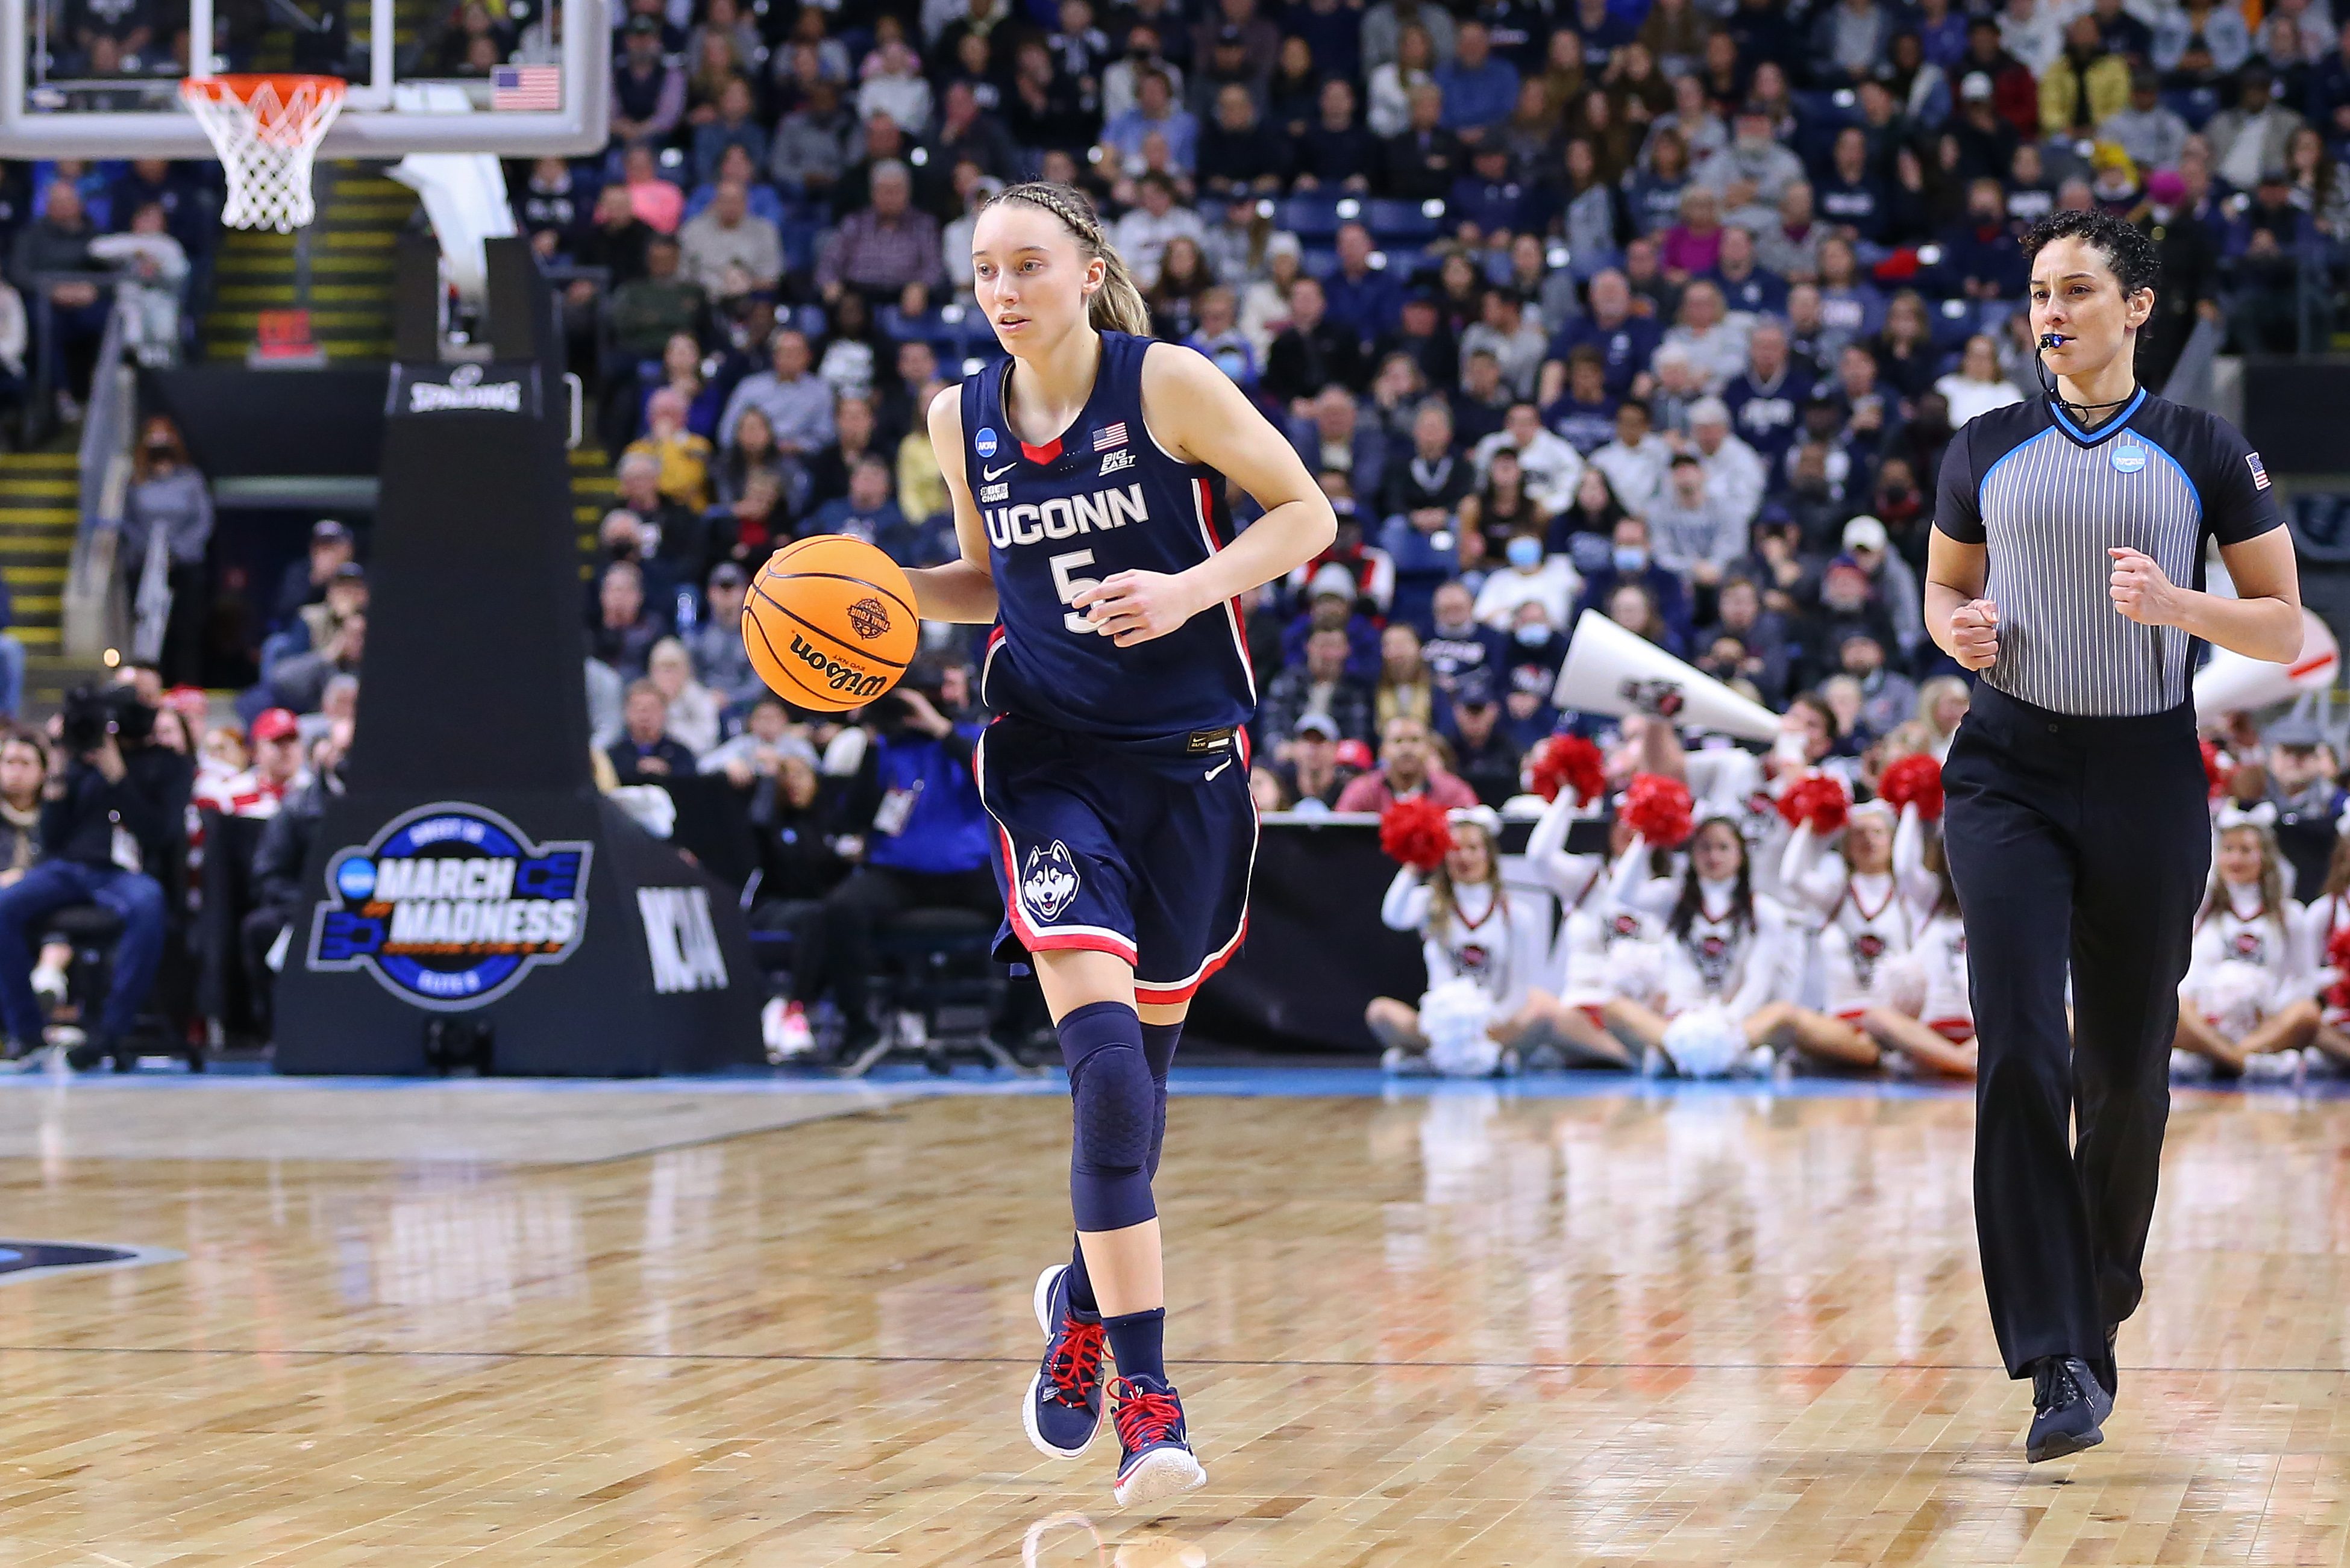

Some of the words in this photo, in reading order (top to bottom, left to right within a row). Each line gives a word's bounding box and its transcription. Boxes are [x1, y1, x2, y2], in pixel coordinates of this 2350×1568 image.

[409, 381, 521, 413] SPALDING
[1100, 455, 1136, 472] EAST
[1103, 449, 1127, 464] BIG
[984, 483, 1148, 549] UCONN
[1048, 548, 1110, 634] 5
[850, 607, 871, 622] FOUR
[871, 615, 889, 631] FINAL
[790, 633, 888, 696] Wilson
[833, 654, 849, 665] NXT
[850, 663, 866, 672] EVO
[372, 857, 518, 901] MARCH
[388, 899, 577, 943] MADNESS
